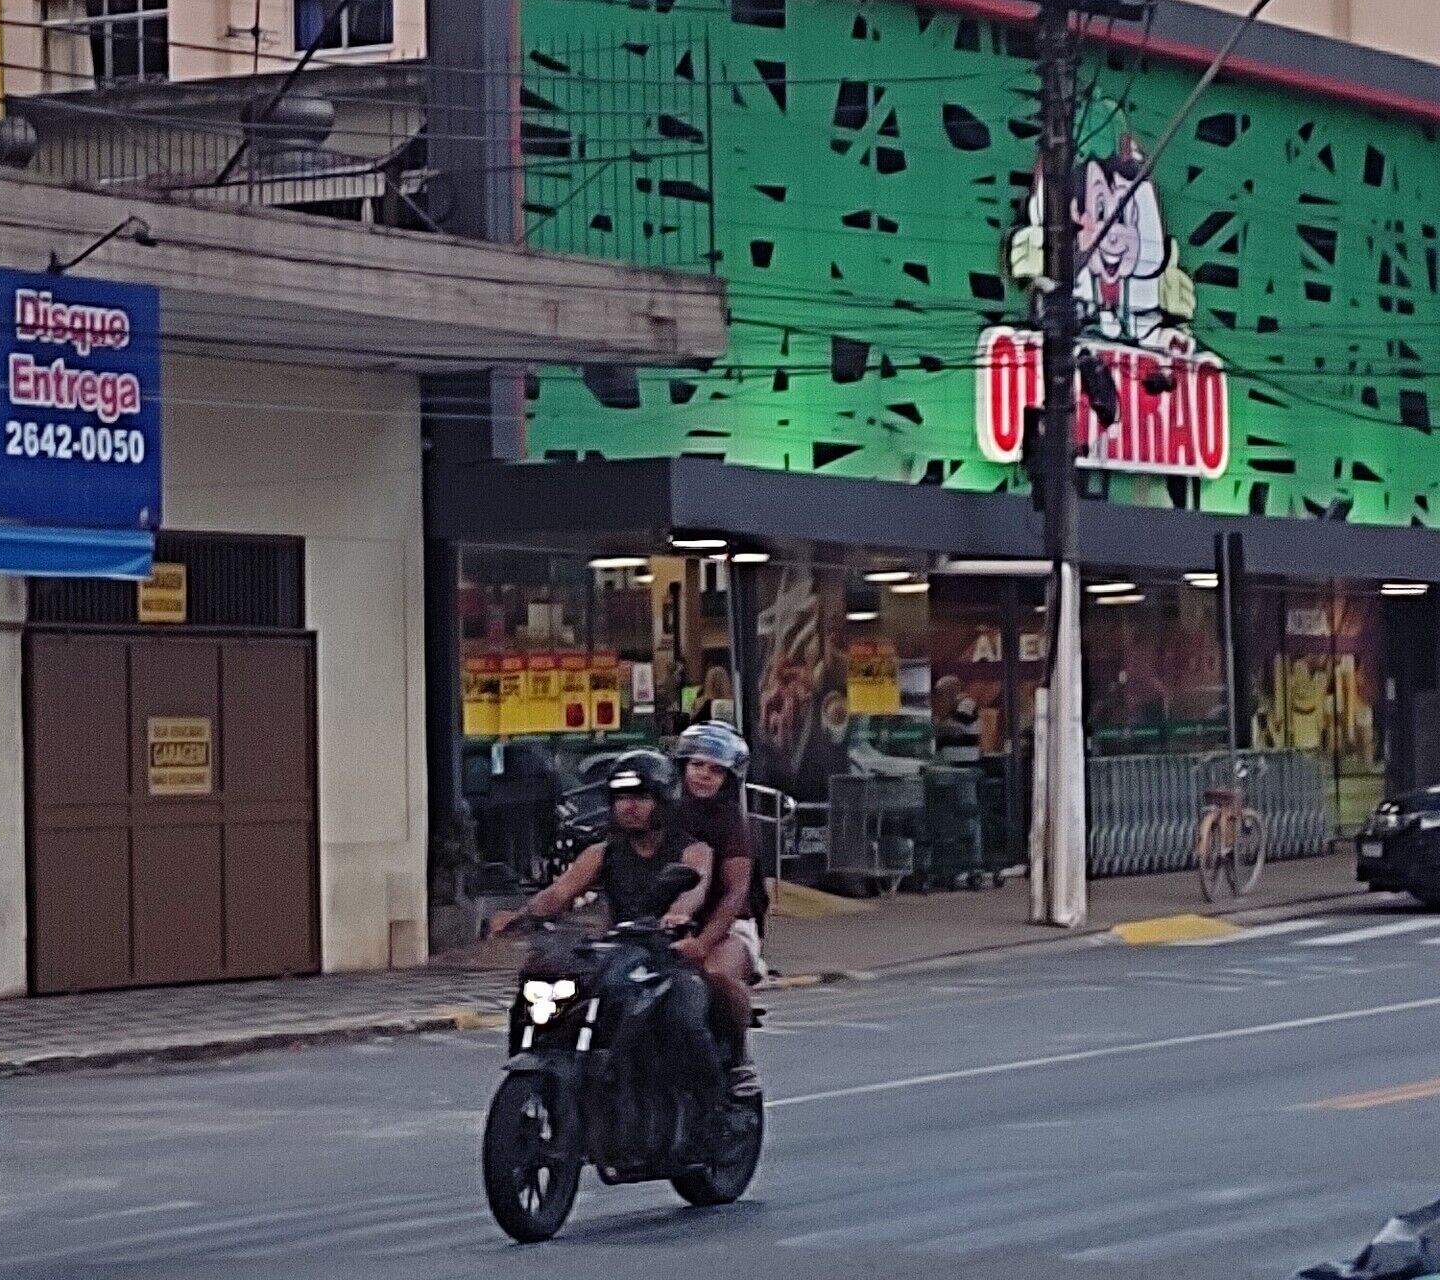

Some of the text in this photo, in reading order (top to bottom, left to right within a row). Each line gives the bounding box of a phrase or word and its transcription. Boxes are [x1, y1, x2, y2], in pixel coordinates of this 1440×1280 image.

[14, 287, 131, 356] Disque
[7, 353, 143, 423] Entrega
[5, 420, 146, 464] 2642-0050
